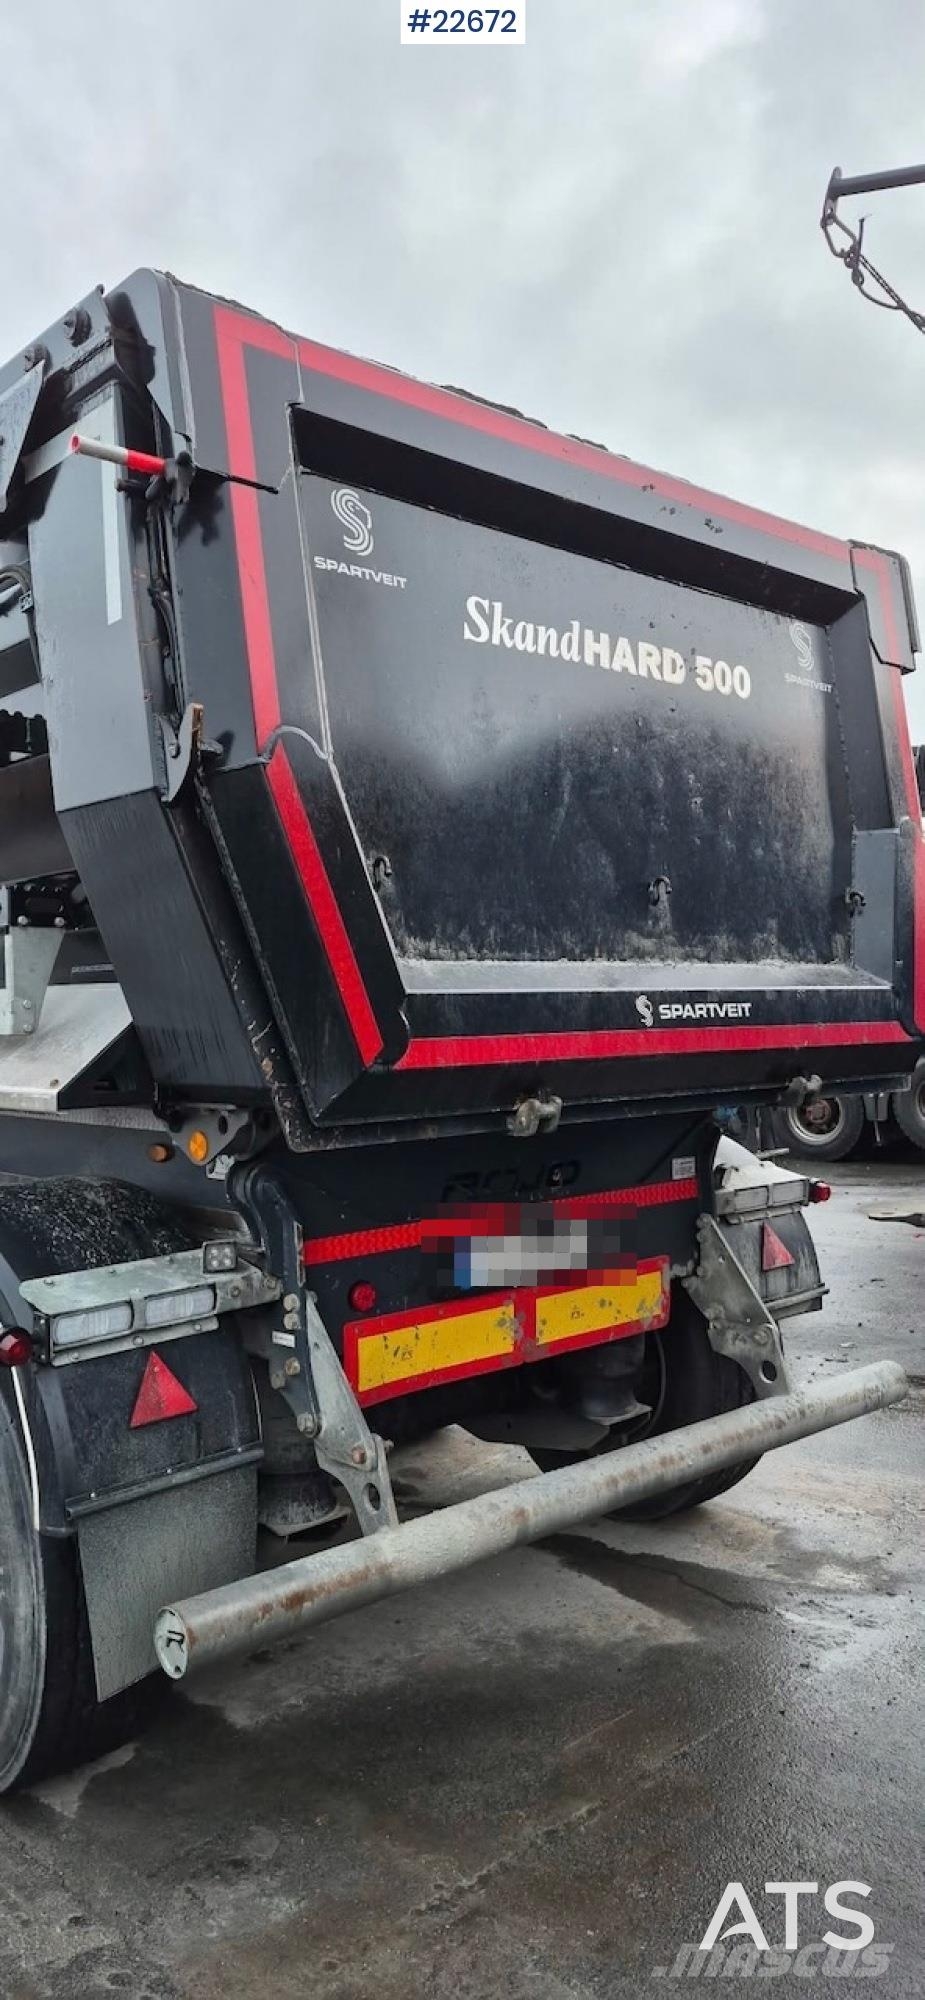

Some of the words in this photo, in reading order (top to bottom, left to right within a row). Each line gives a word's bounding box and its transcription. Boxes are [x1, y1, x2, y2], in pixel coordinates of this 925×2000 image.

[313, 556, 408, 589] SPARTVEIT
[694, 655, 751, 700] 500
[658, 1003, 752, 1020] SPARTVEIT
